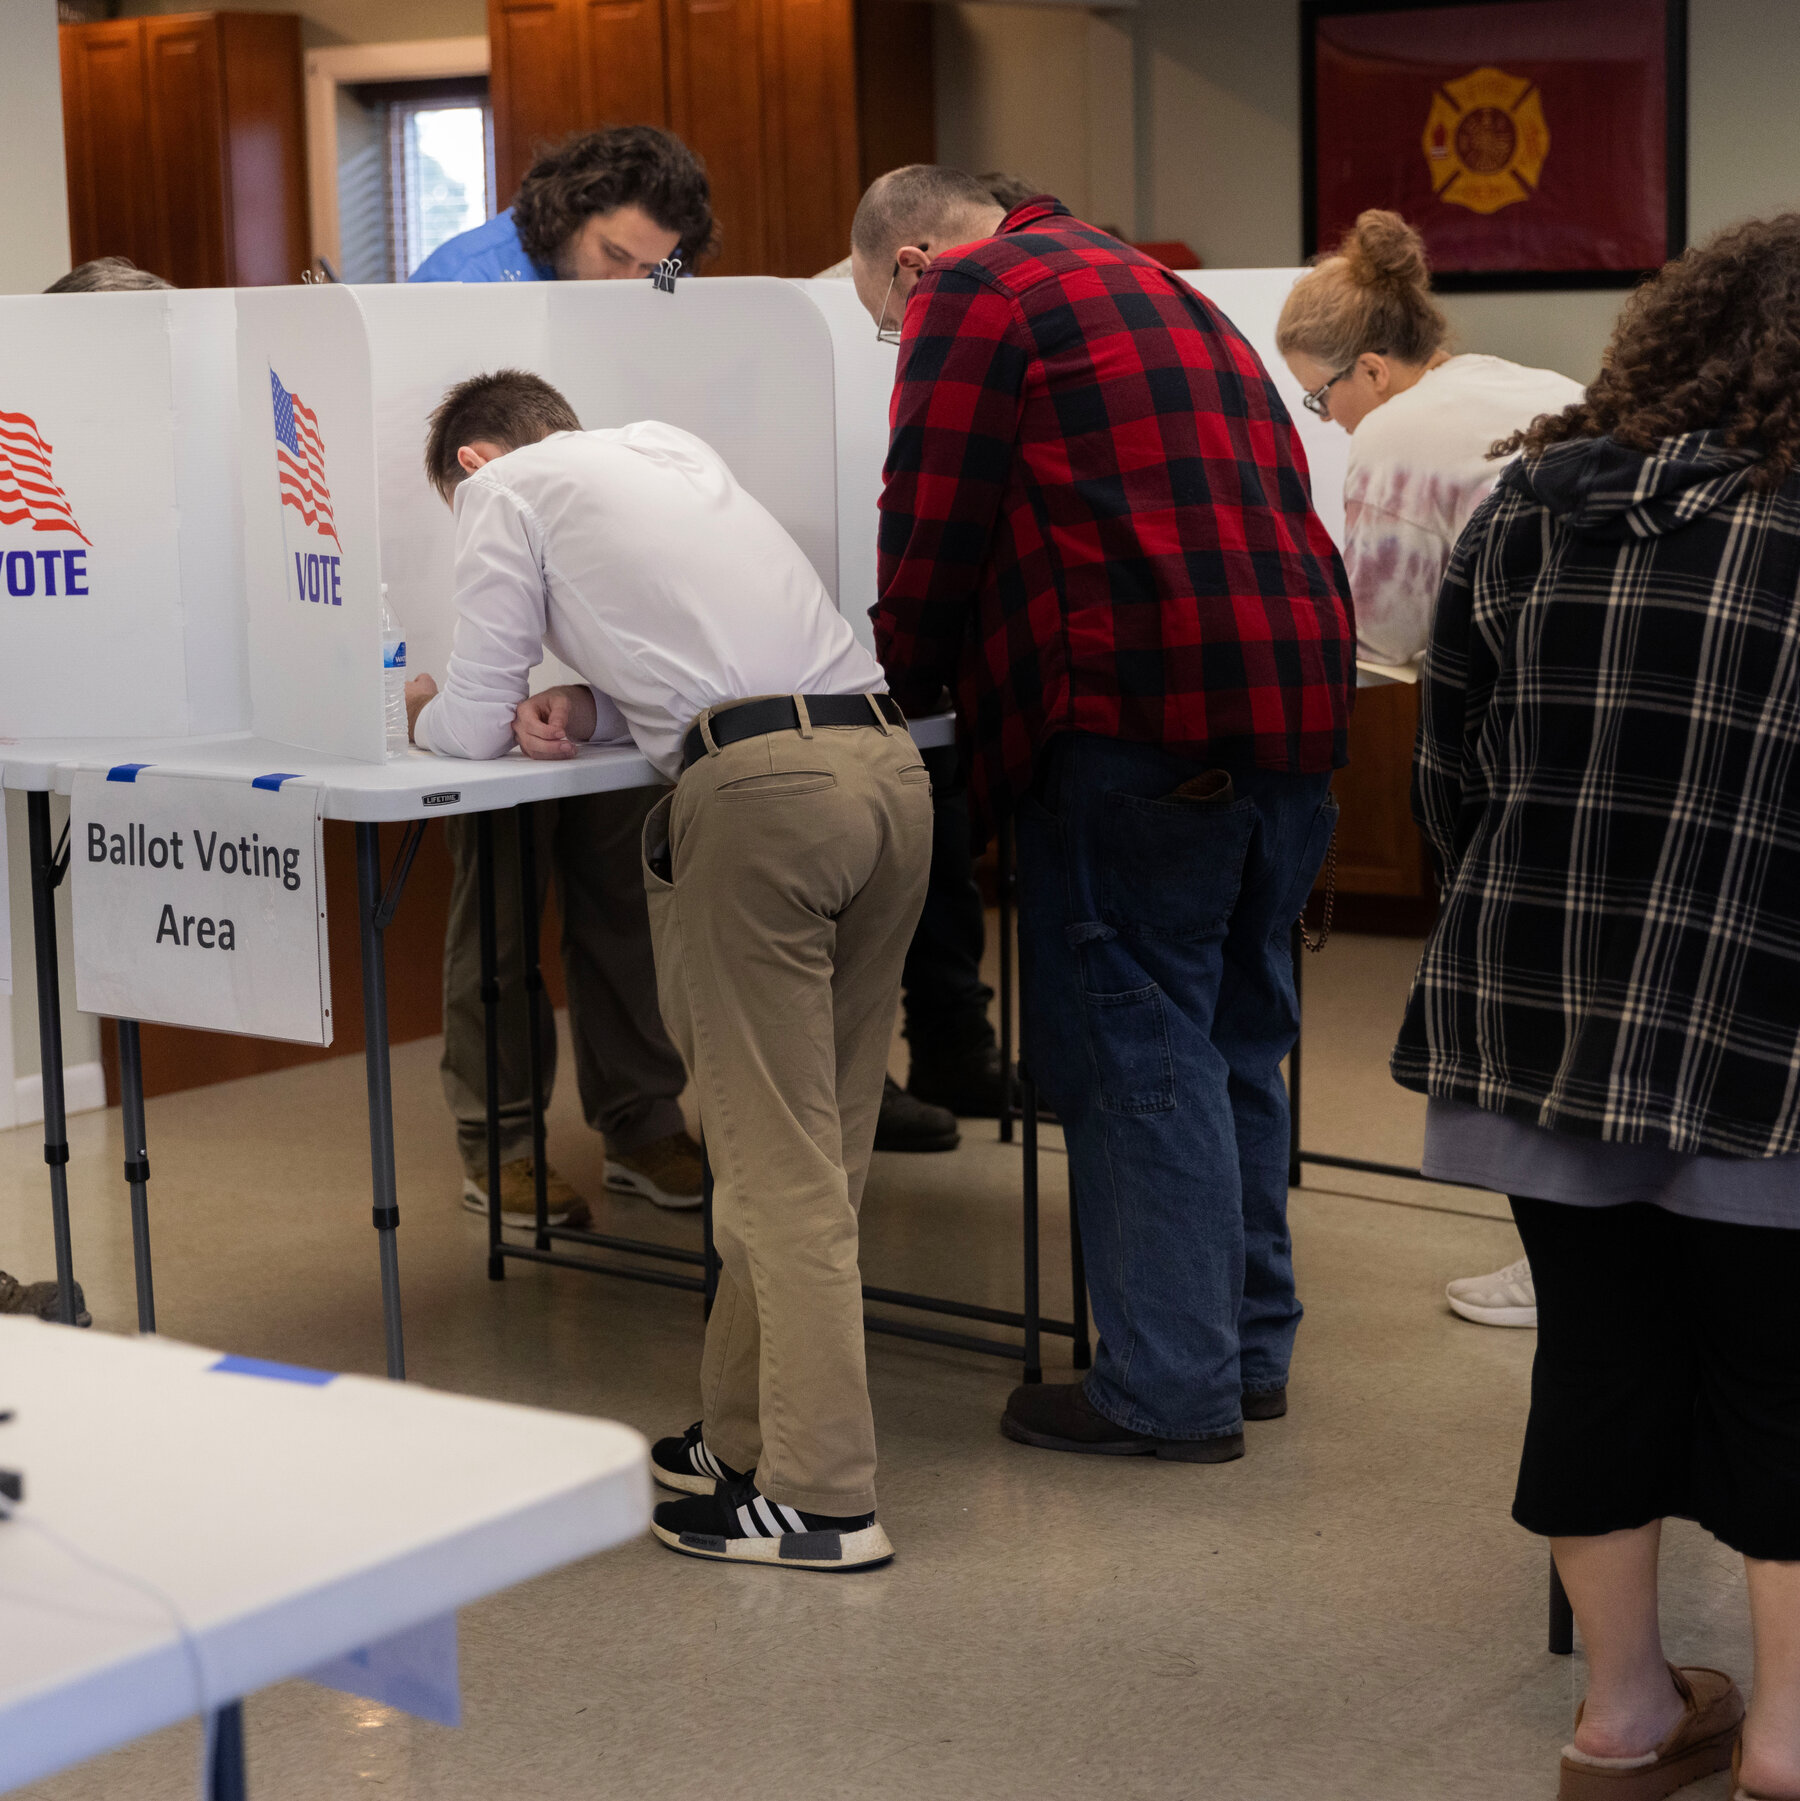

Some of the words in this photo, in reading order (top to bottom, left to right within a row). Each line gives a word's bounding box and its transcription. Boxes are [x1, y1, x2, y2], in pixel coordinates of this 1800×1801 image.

[0, 549, 89, 597] OTE
[295, 551, 342, 606] VOTE
[425, 793, 457, 804] LIFETIME
[88, 823, 183, 869] Ballot
[193, 829, 301, 890] Voting
[155, 903, 236, 951] Area
